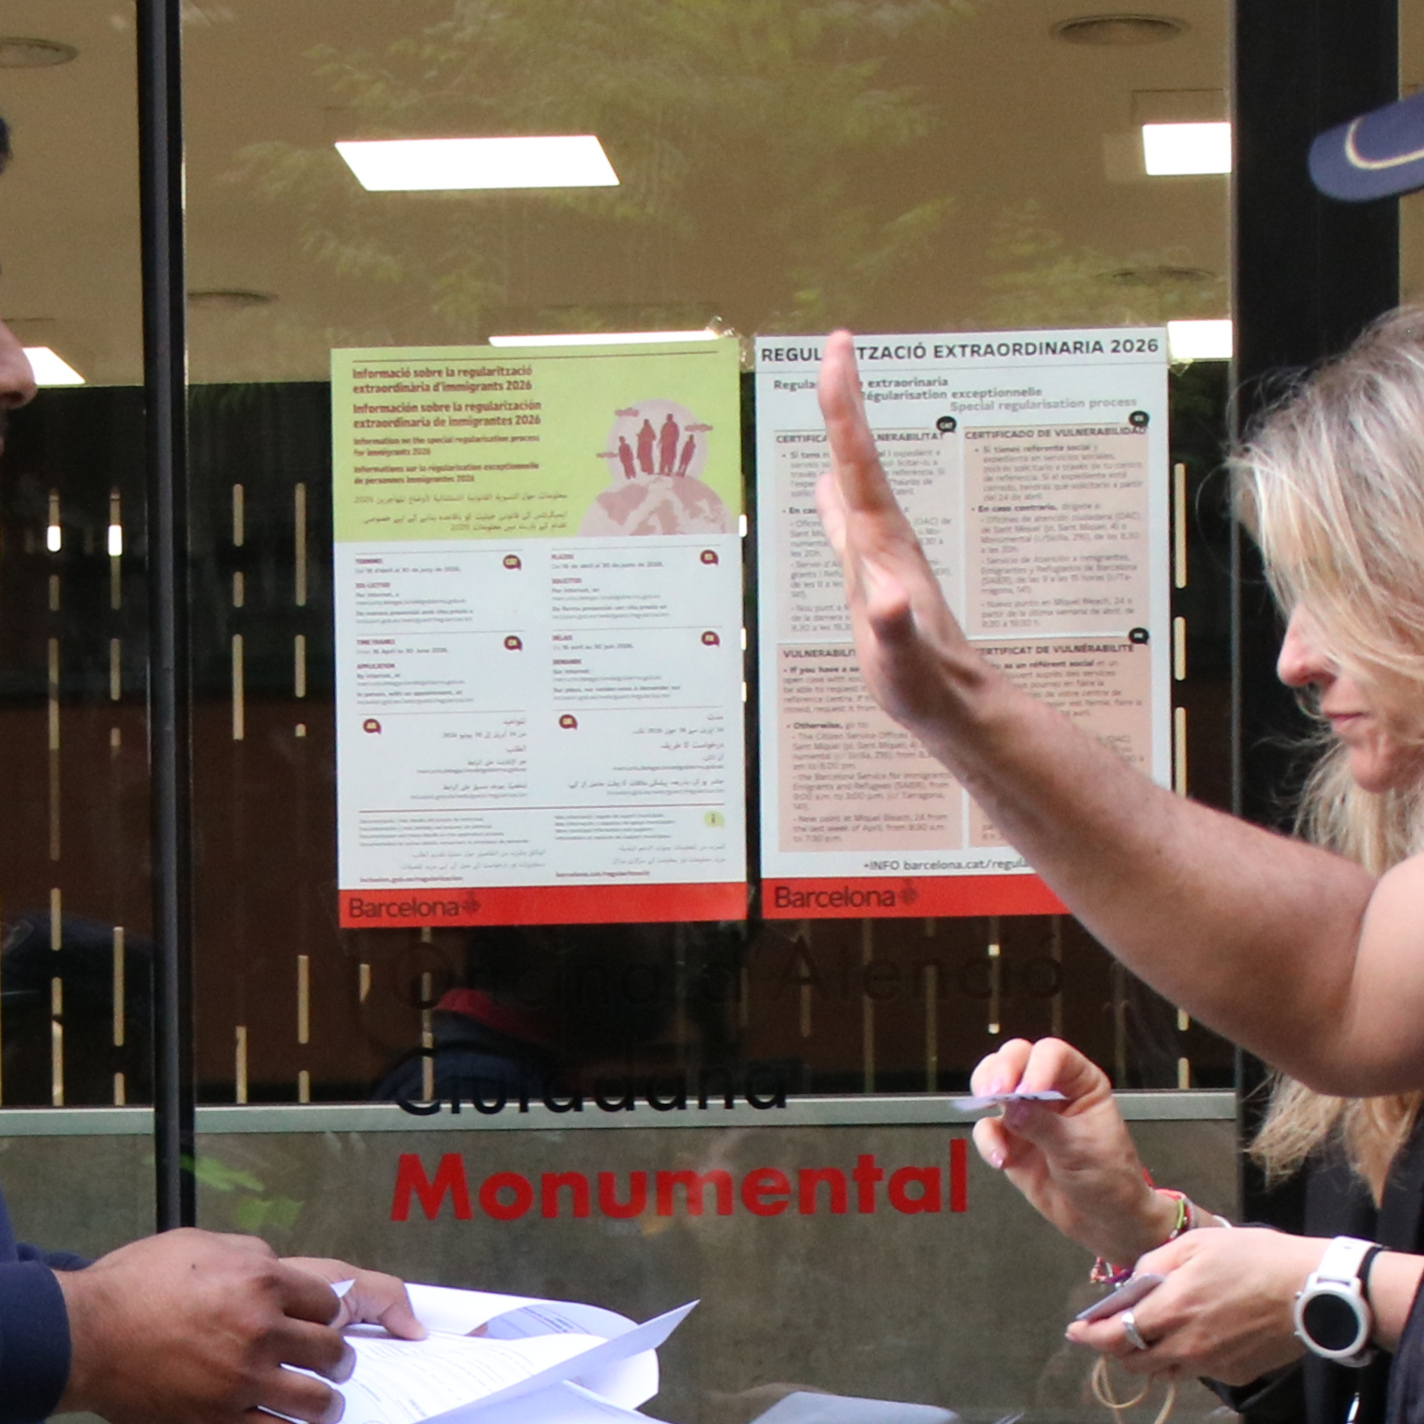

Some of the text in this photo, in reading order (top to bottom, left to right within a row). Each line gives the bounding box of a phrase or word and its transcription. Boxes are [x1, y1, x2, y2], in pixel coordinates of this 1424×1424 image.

[761, 338, 1159, 362] REGULTZACIÓ EXTRAORDINARIA 2026
[353, 368, 410, 379] Informació
[414, 368, 443, 378] sobre
[446, 367, 456, 378] la
[353, 382, 431, 394] extraordinària
[506, 380, 532, 391] 2026
[867, 377, 949, 388] extraorinaria
[952, 386, 1043, 400] exceptionnelle
[353, 400, 542, 414] Información sobre la regularización
[950, 398, 1137, 413] Special regularisation process
[353, 416, 431, 428] extraordinaria
[433, 416, 446, 427] de
[515, 414, 542, 426] 2026
[776, 434, 828, 444] CERTIFICA
[964, 426, 1147, 440] CERTIFICADO DE VULNERABILIDAD
[1036, 646, 1050, 654] DE
[1069, 660, 1095, 668] social
[863, 858, 1029, 872] +INFO barcelona.cat/regula
[774, 885, 896, 908] Barcelona
[348, 896, 460, 918] Barcelona
[390, 1138, 968, 1222] Monumental
